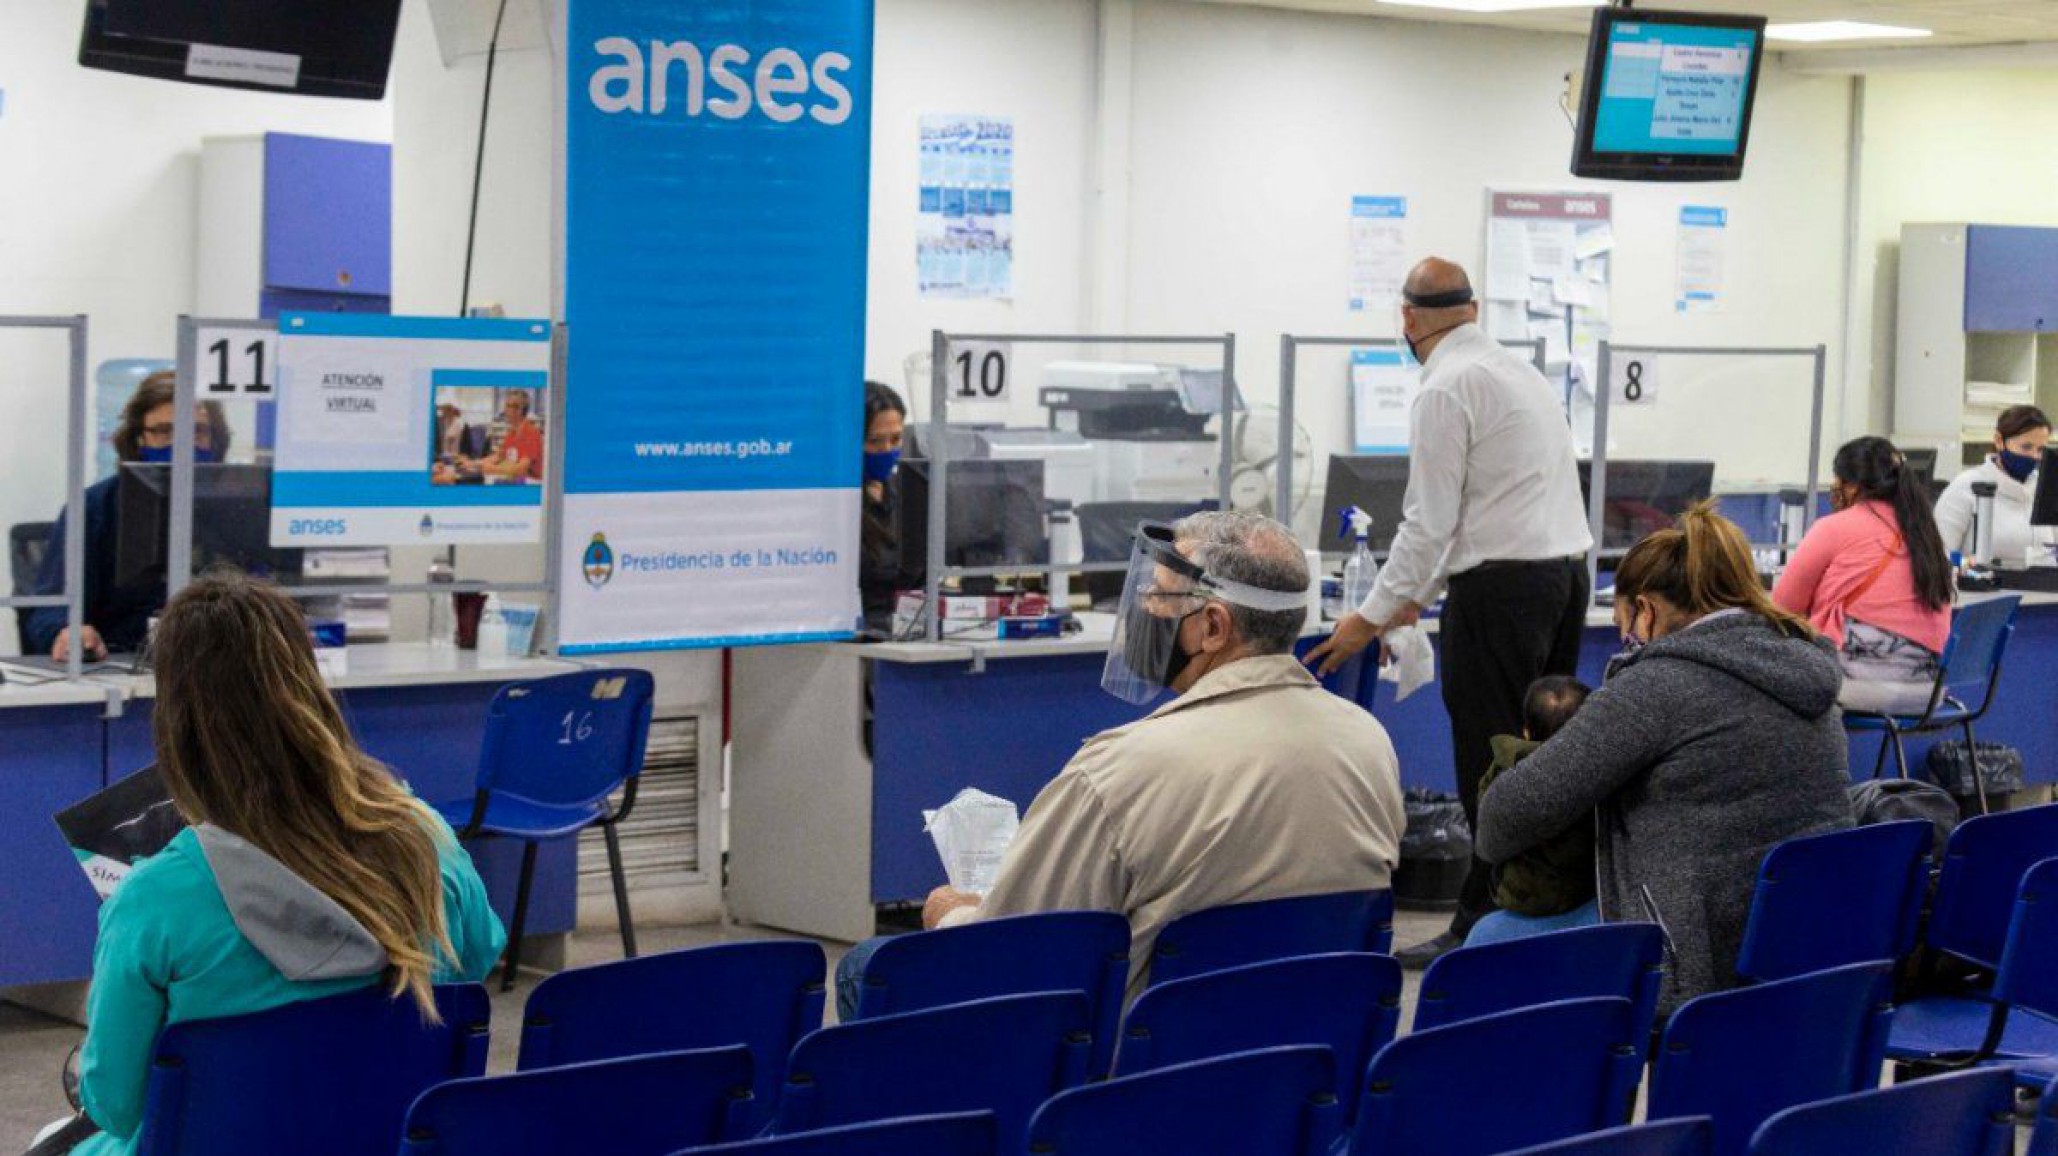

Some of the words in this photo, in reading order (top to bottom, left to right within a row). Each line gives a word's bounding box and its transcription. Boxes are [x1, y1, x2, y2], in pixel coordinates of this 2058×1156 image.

[589, 36, 853, 125] anses
[208, 338, 272, 393] 11
[321, 372, 384, 388] ATENCIÓN
[956, 350, 1005, 397] 10
[1625, 361, 1643, 401] 8
[325, 397, 376, 411] VIRTUAL
[634, 439, 793, 459] www.anses.gob.ar
[288, 517, 347, 535] anses
[621, 552, 724, 572] Presidencia
[730, 550, 752, 568] de
[757, 549, 773, 567] la
[777, 546, 838, 566] Nación
[558, 711, 593, 744] 16
